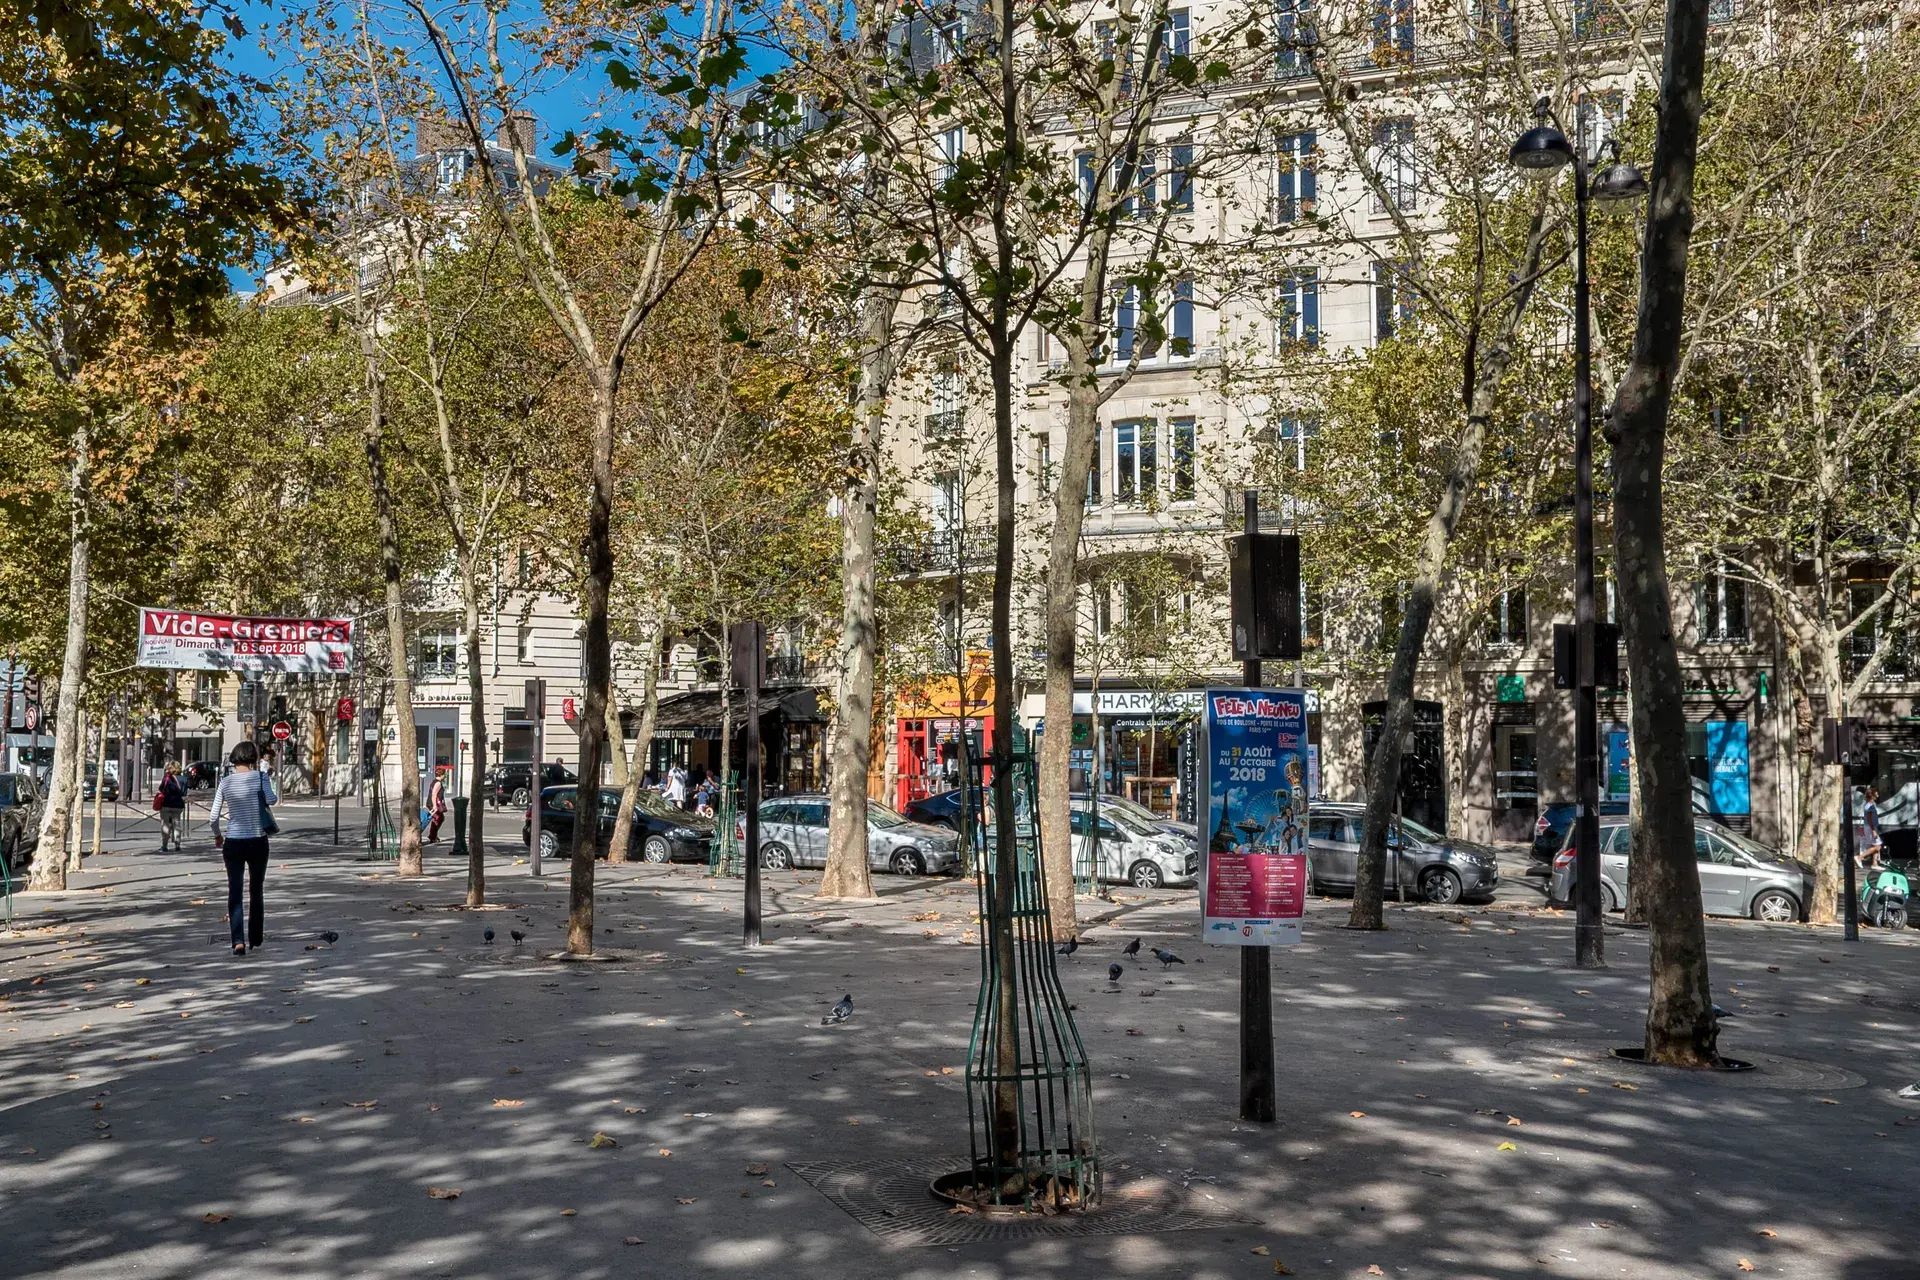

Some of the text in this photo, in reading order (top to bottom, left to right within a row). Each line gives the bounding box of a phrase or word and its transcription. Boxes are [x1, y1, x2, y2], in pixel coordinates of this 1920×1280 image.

[175, 639, 306, 654] Dimanche 16 Sept 2018
[1231, 747, 1242, 757] 31
[1244, 745, 1273, 757] AOÛT
[1219, 758, 1276, 767] AU 7 OCTOBRE
[1229, 767, 1266, 781] 2018
